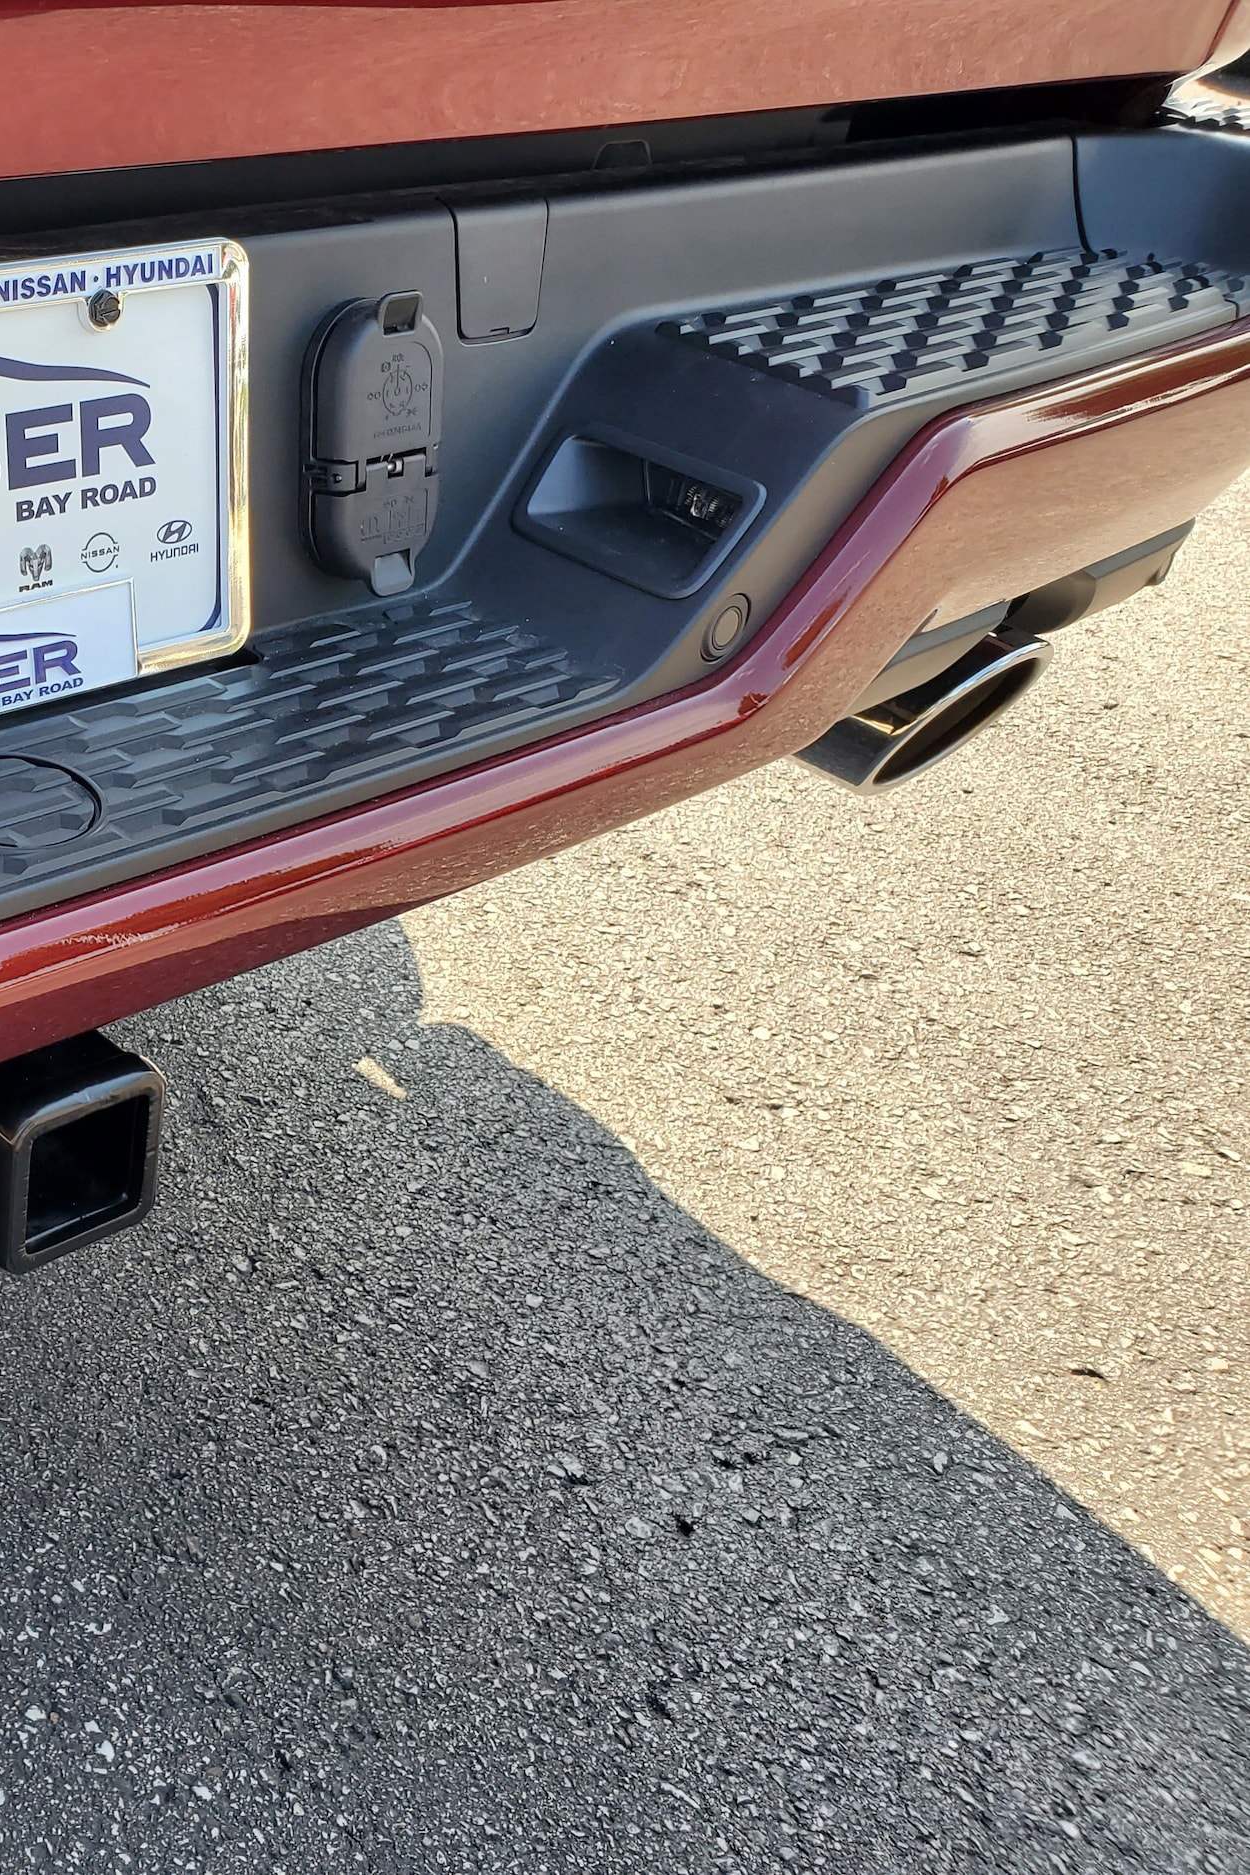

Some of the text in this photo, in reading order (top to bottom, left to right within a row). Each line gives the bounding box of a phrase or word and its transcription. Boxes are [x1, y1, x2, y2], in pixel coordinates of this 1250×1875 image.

[106, 253, 214, 288] HYUNDAI
[16, 477, 157, 522] BAY ROAD
[81, 545, 120, 561] NISSAN
[150, 543, 199, 562] HYUNDAI
[19, 579, 53, 593] RAM
[2, 689, 35, 707] BAY
[39, 677, 84, 697] ROAD
